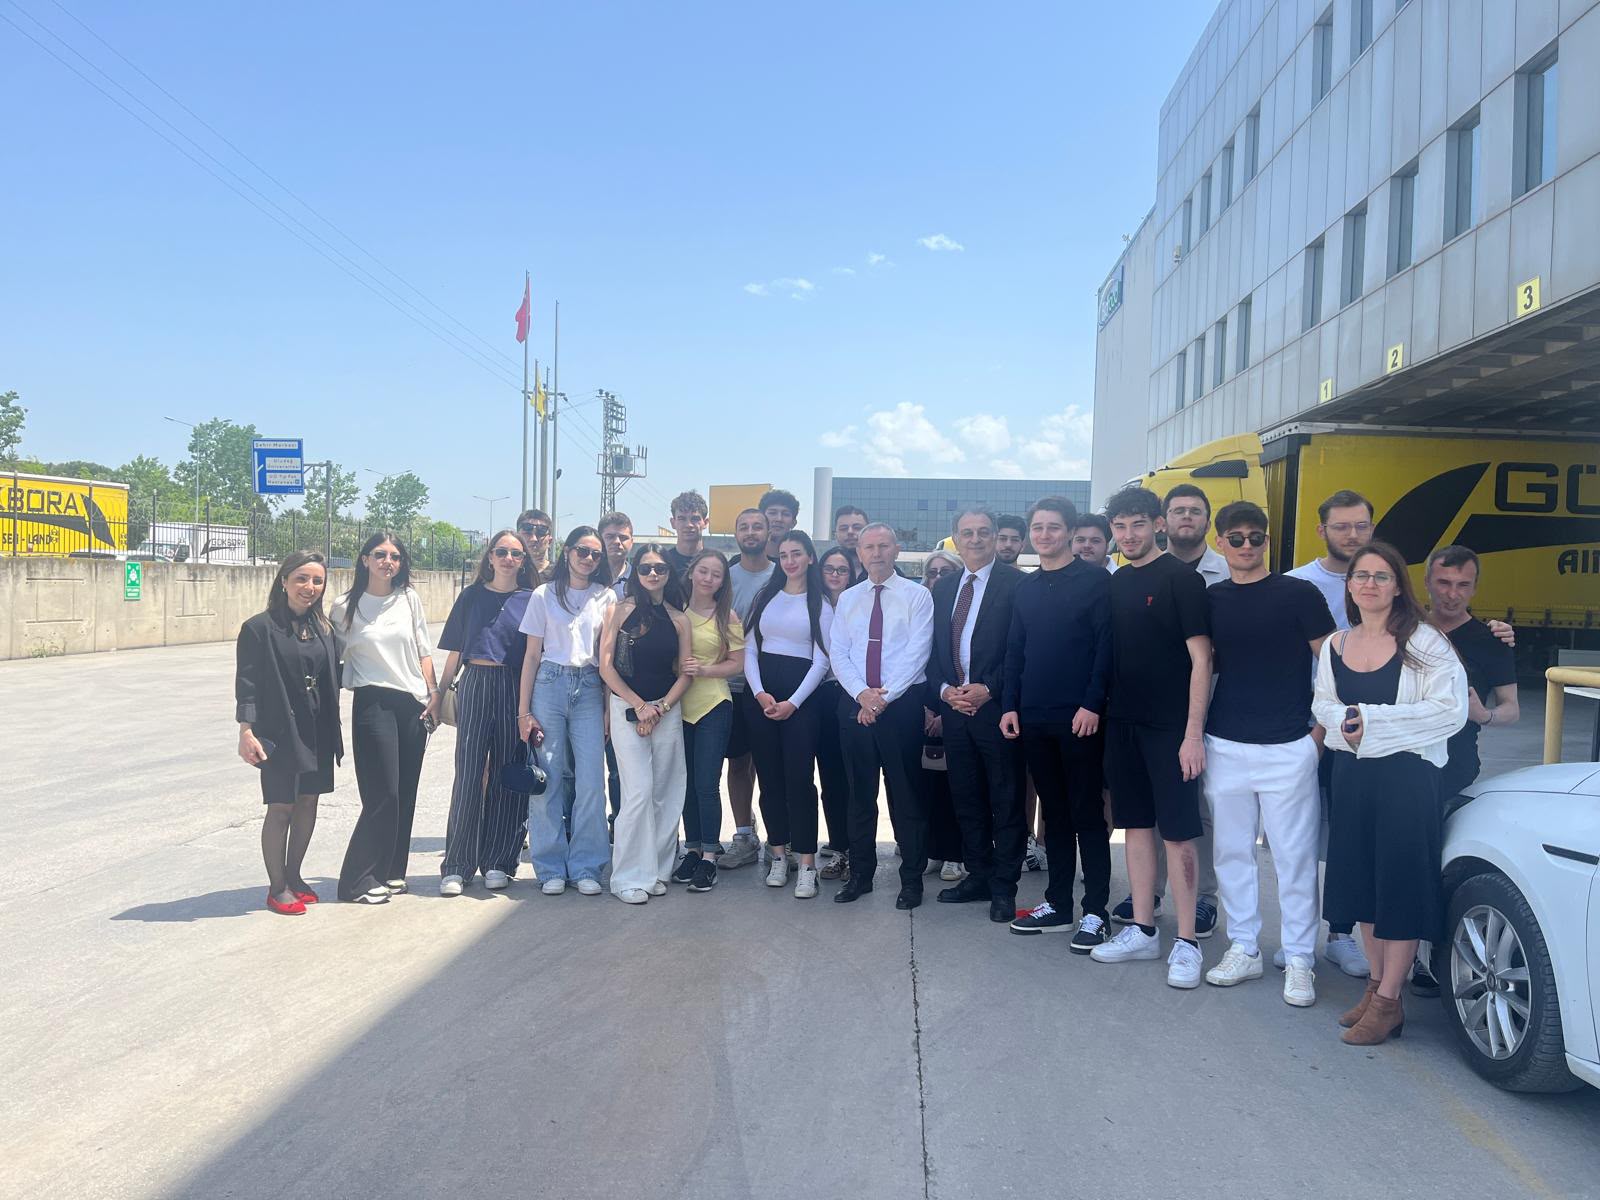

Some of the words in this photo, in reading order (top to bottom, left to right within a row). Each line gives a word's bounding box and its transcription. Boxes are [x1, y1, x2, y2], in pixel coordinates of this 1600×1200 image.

[1523, 285, 1534, 310] 3
[1391, 349, 1399, 369] 2
[1324, 384, 1329, 398] 1
